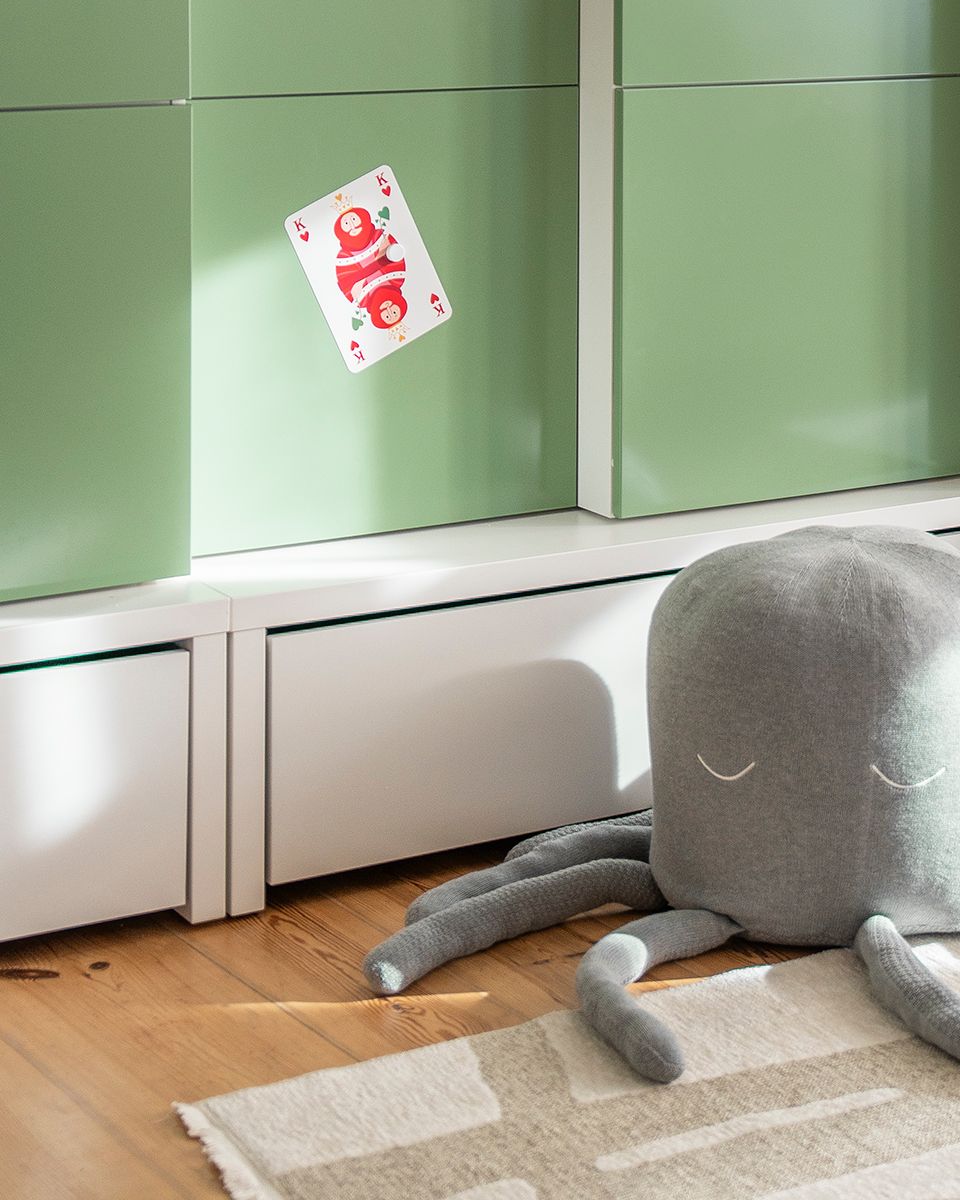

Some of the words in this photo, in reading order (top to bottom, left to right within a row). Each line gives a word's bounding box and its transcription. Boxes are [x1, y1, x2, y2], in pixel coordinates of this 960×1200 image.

[375, 172, 389, 187] K
[293, 217, 307, 232] K
[432, 303, 446, 317] K
[353, 351, 366, 365] K
